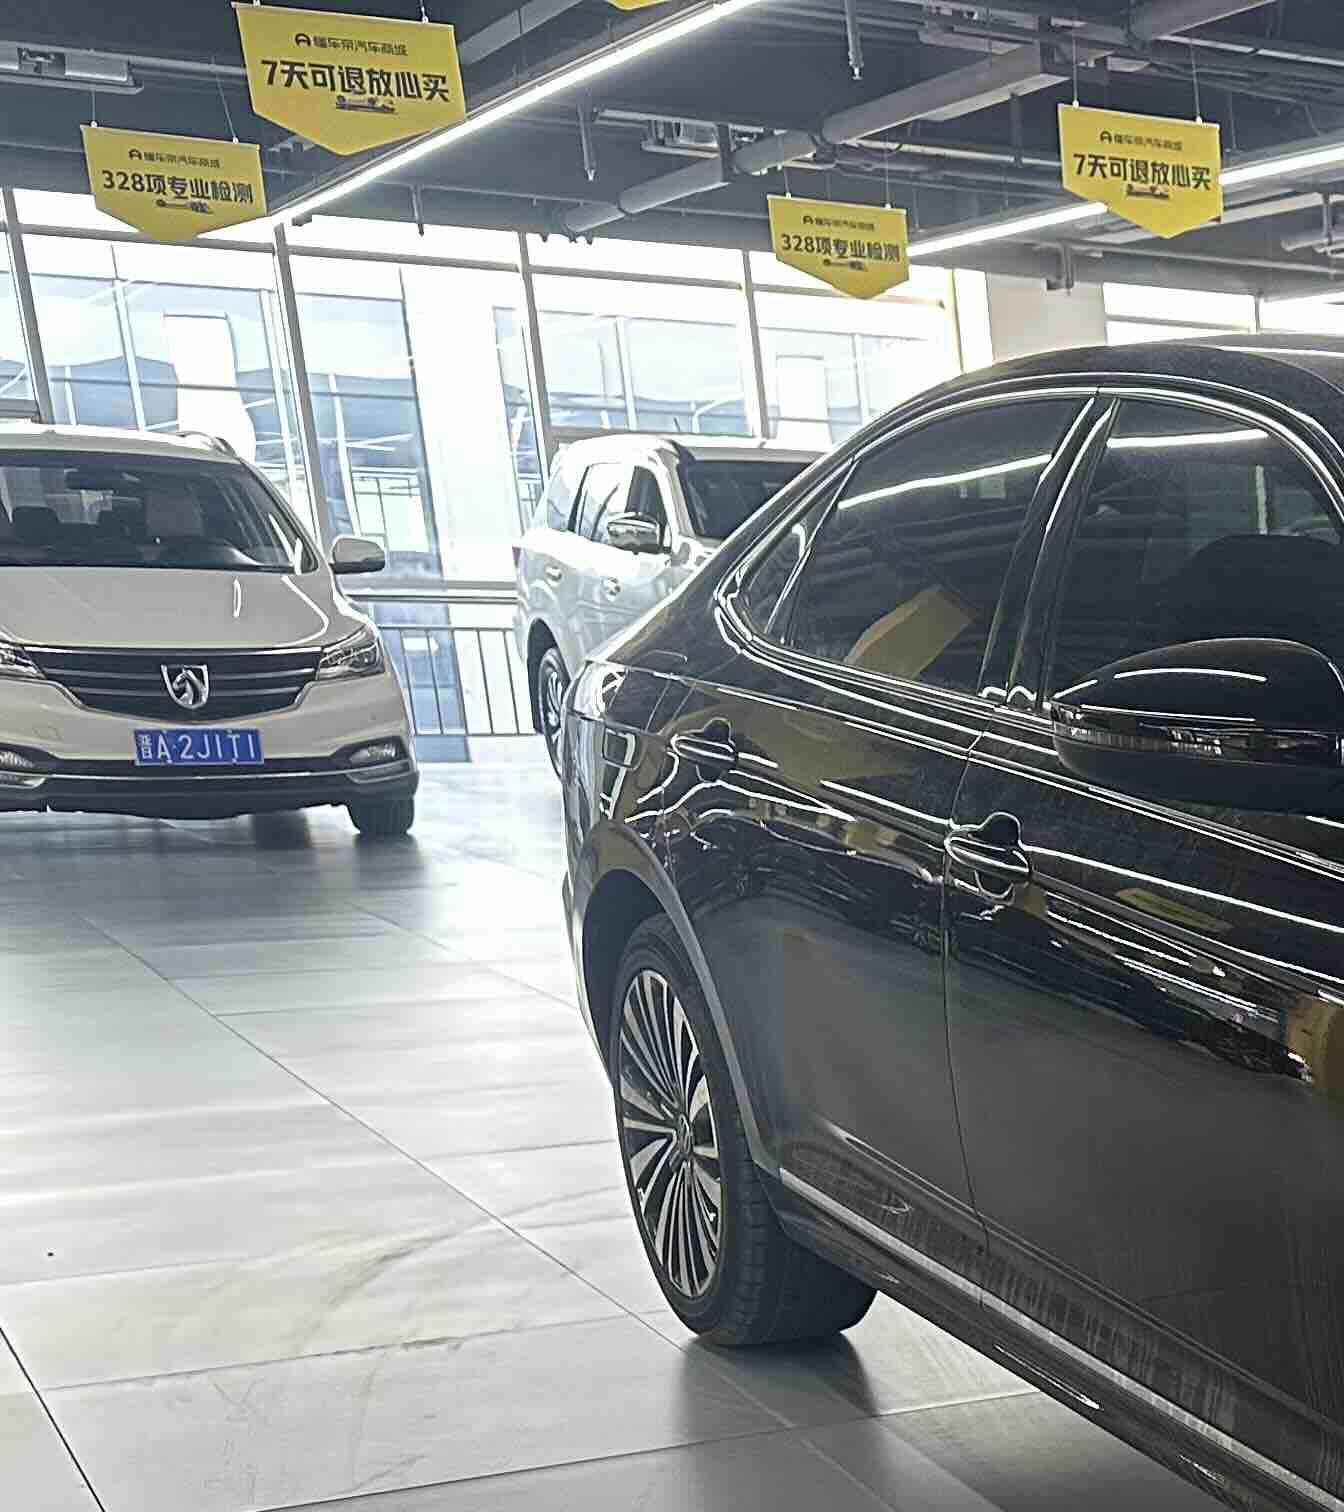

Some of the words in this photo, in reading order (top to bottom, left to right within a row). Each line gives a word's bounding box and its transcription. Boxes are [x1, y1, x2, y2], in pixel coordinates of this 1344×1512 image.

[261, 60, 450, 102] 7天可退放心买
[102, 170, 254, 204] 328项专业检测
[1073, 153, 1212, 191] 7天可退放心买
[781, 234, 900, 262] 328项专业检测
